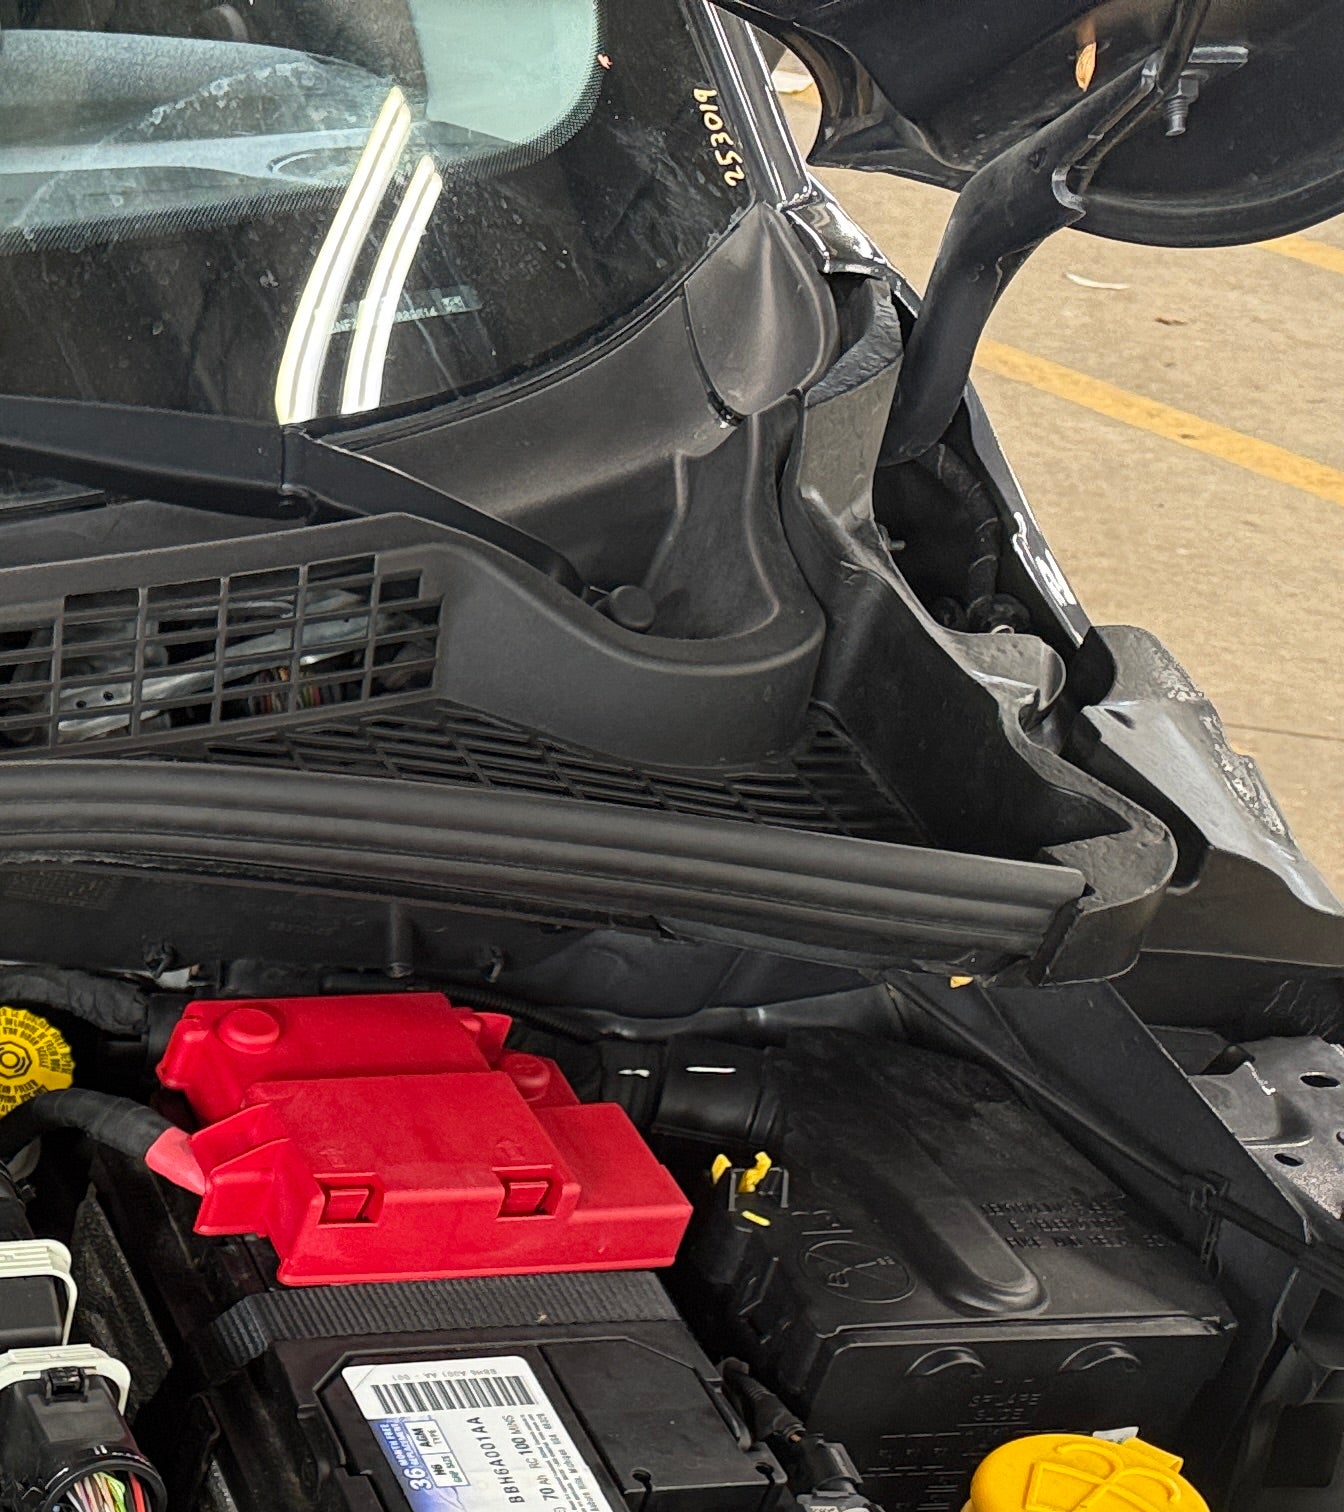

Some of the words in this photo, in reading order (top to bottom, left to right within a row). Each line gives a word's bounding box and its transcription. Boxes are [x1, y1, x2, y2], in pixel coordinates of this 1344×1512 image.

[692, 88, 745, 187] 253019
[379, 1423, 395, 1439] FREE
[410, 1426, 431, 1447] AGM
[510, 1437, 533, 1454] 100
[464, 1416, 525, 1503] BBH6A001AA
[401, 1466, 434, 1490] 36
[538, 1487, 559, 1500] 70
